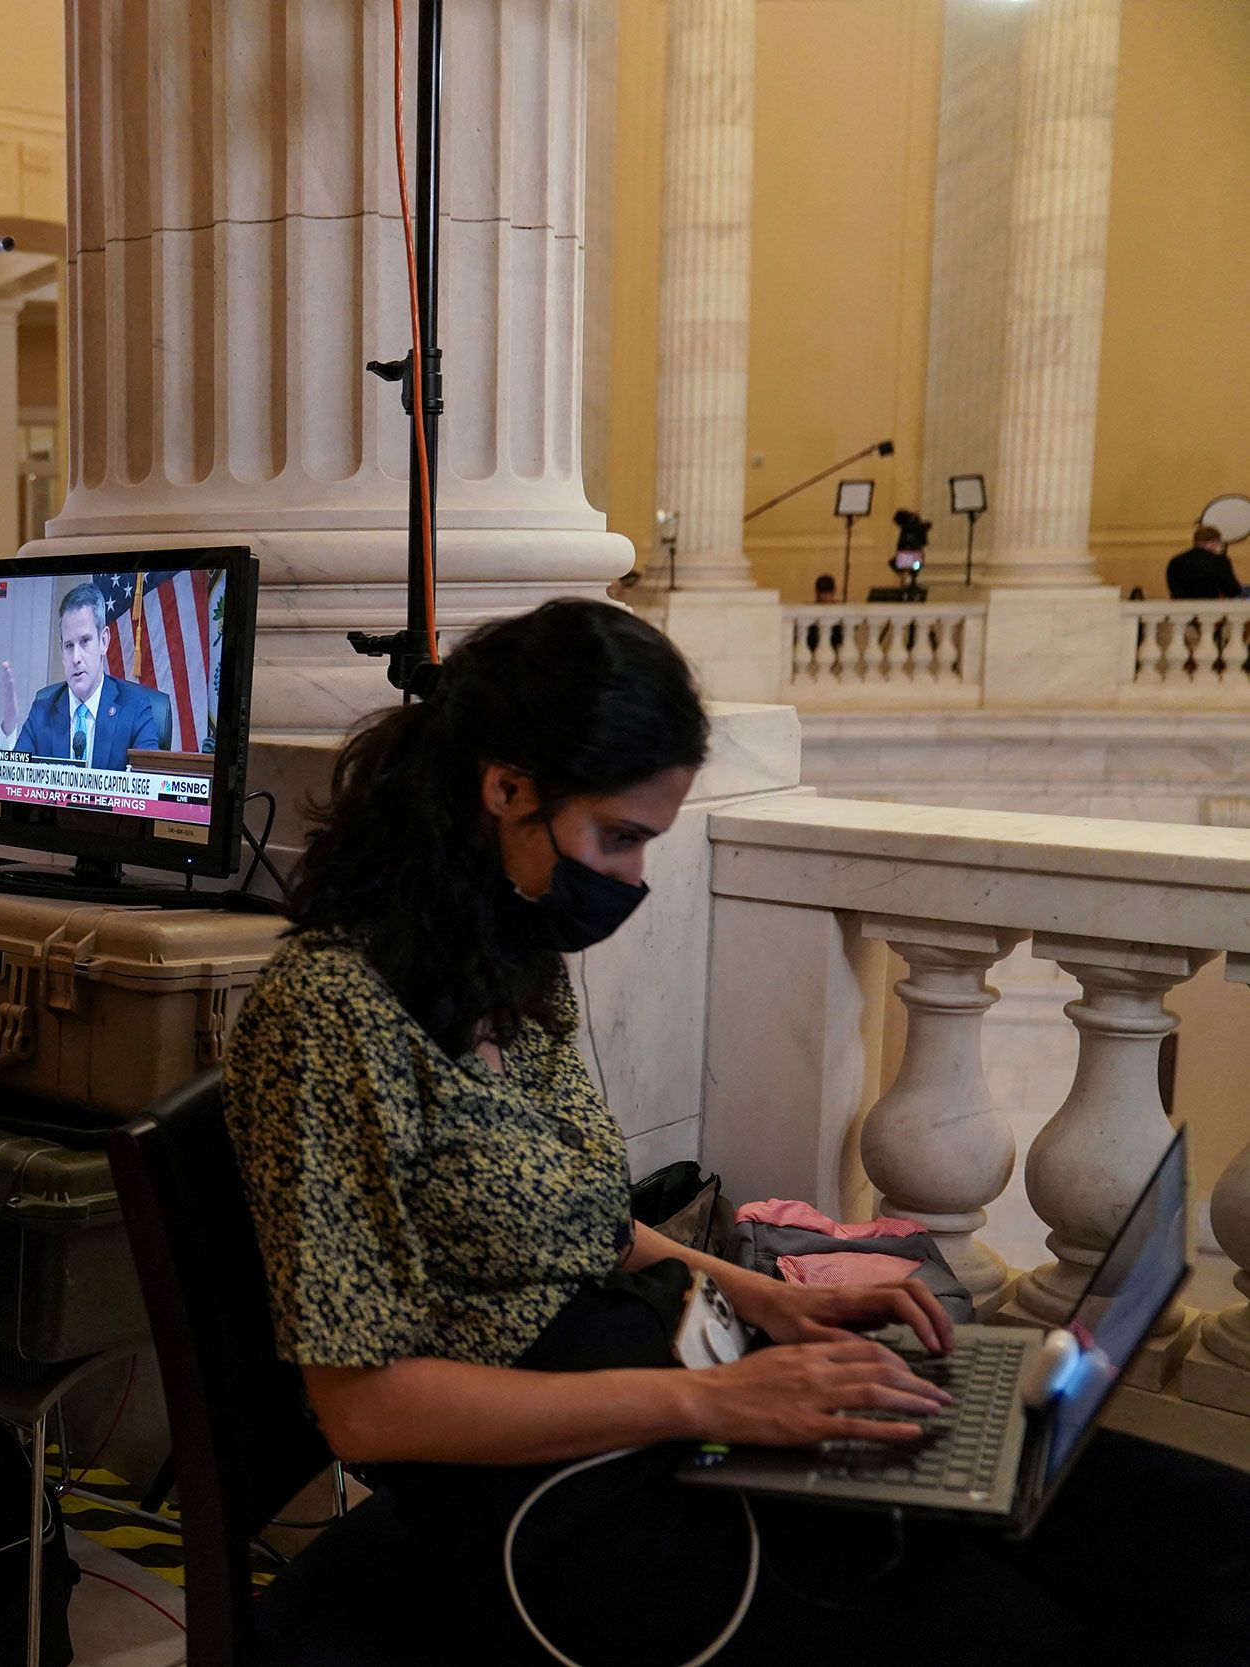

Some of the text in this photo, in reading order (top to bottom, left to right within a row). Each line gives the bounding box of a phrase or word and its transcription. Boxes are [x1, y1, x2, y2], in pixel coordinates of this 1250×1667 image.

[10, 752, 30, 762] NEWS
[16, 766, 26, 781] ON
[26, 767, 50, 785] TRUMP'S
[50, 769, 79, 787] INACTION
[79, 773, 103, 790] DURING
[104, 775, 130, 793] CAPITOL
[131, 777, 150, 796] SIEGE
[171, 781, 208, 795] MSNBC
[6, 786, 146, 811] THE JANUARY 6TH HEARINGS
